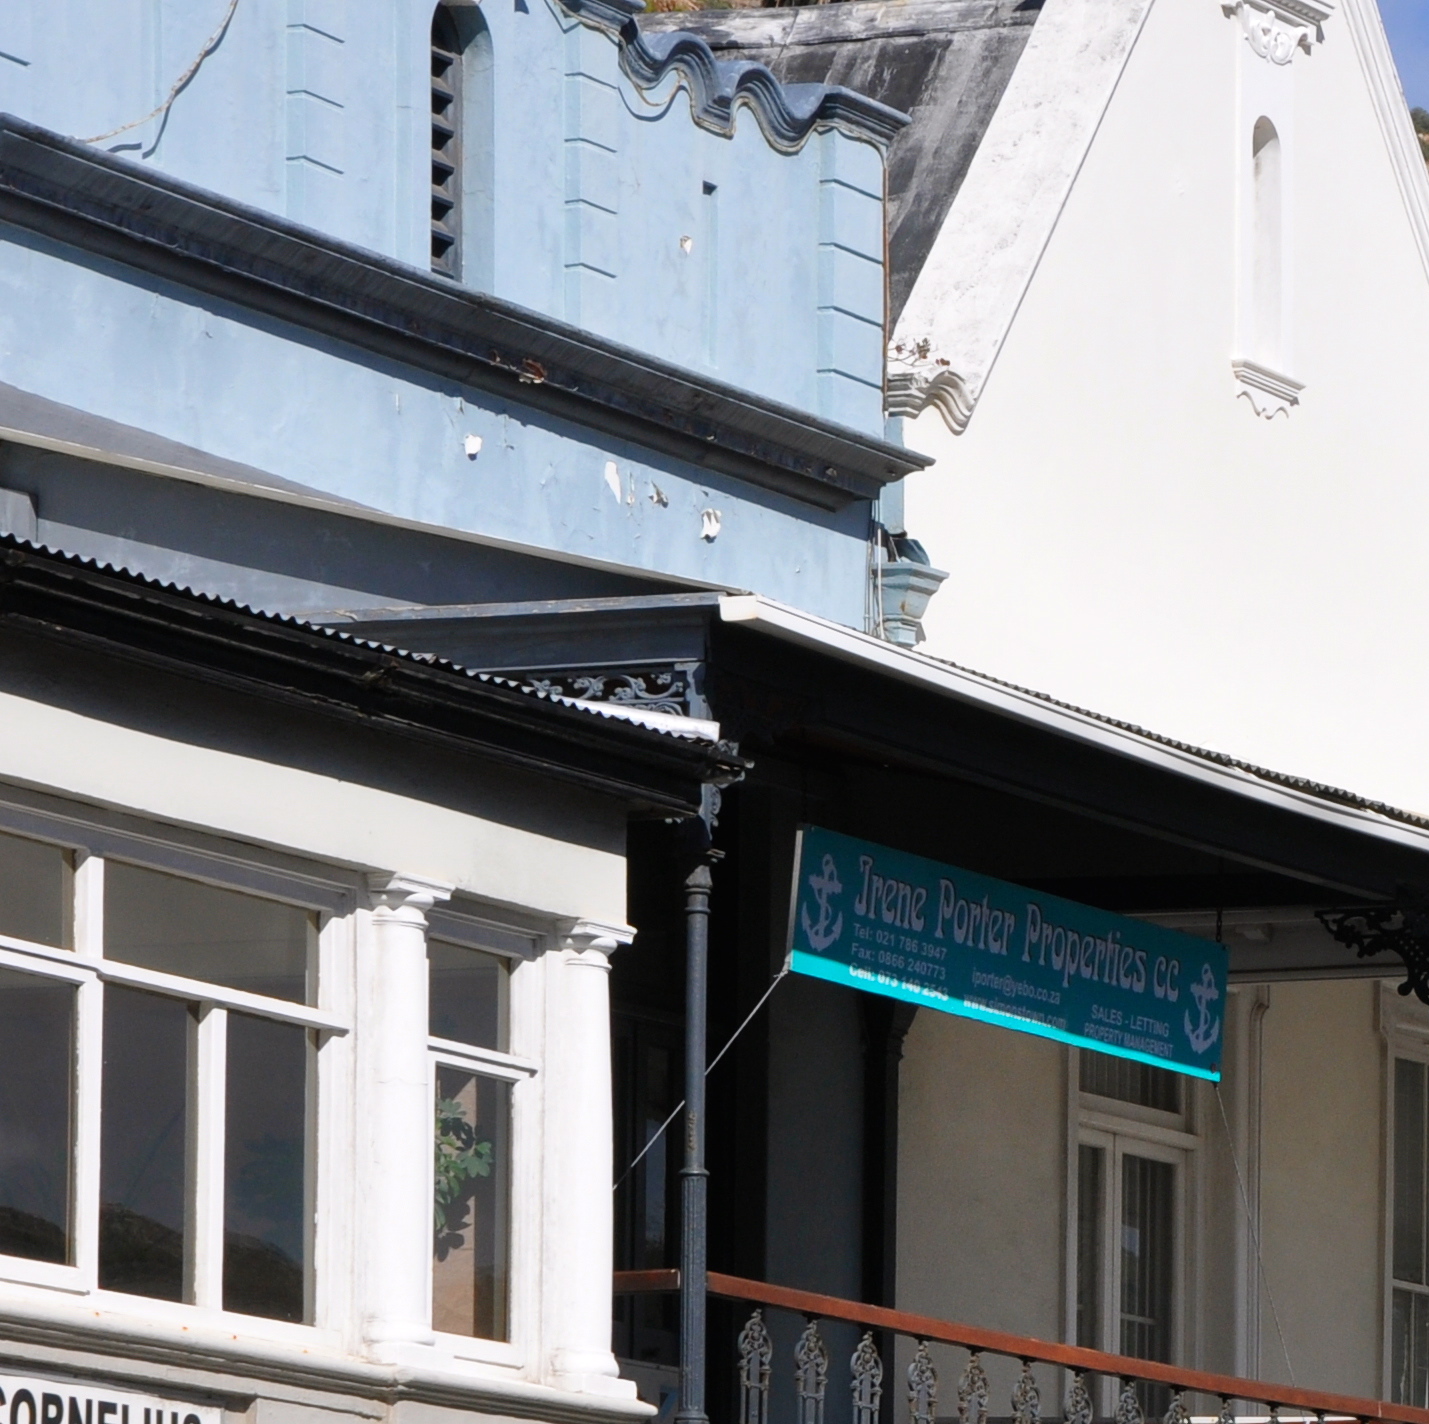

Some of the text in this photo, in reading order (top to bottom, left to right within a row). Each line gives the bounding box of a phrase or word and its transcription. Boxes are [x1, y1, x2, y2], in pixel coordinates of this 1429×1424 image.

[853, 923, 948, 961] Tel: 021 786 3947
[934, 878, 1015, 956] Porter
[1022, 903, 1148, 992] Properties
[851, 943, 875, 962] Fax:
[907, 958, 947, 981] 240773
[1084, 1023, 1124, 1046] PROPERTY
[1091, 1004, 1122, 1027] SALES
[1130, 1014, 1170, 1038] LETTING
